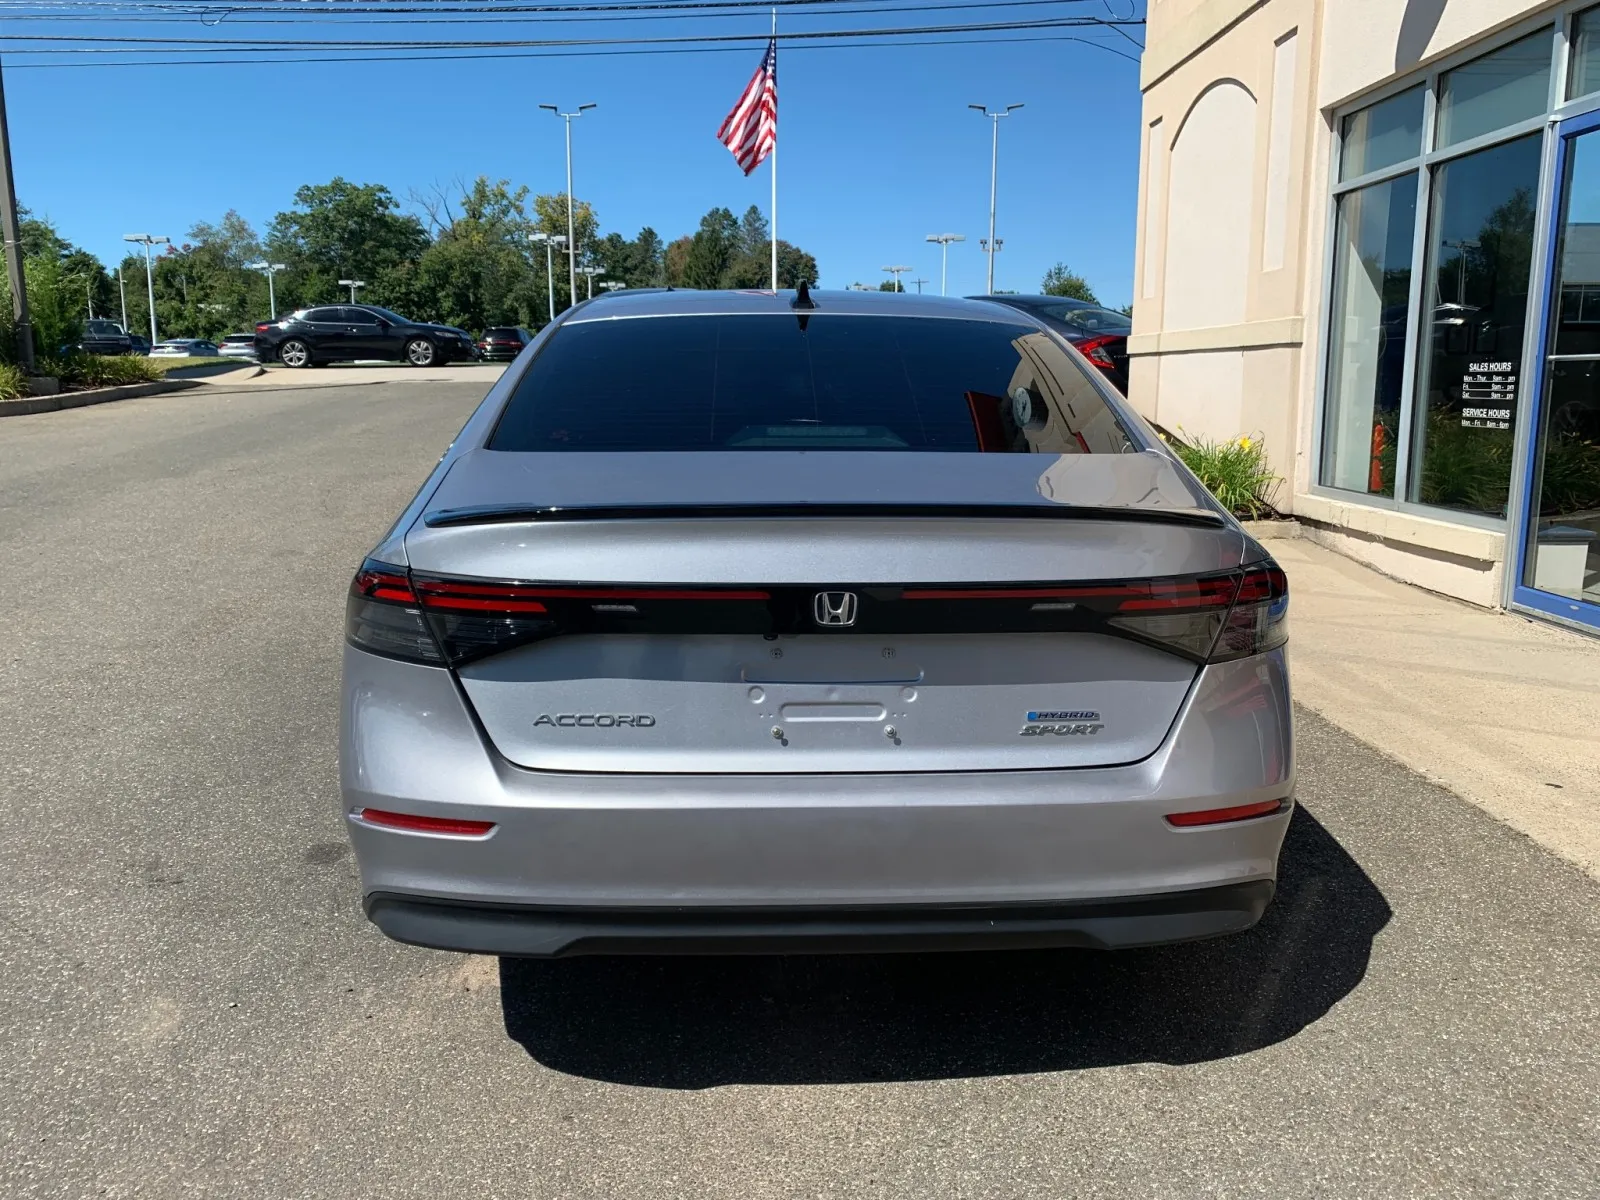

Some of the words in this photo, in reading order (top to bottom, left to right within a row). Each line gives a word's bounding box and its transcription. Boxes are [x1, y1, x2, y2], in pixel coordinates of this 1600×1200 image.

[1469, 363, 1488, 371] SALES
[1489, 362, 1511, 371] HOURS
[1462, 408, 1487, 417] SERVICE
[1488, 409, 1510, 418] HOURS
[533, 713, 656, 727] ACCORD
[1037, 711, 1095, 719] HYBRID
[1019, 723, 1104, 736] SPORT
